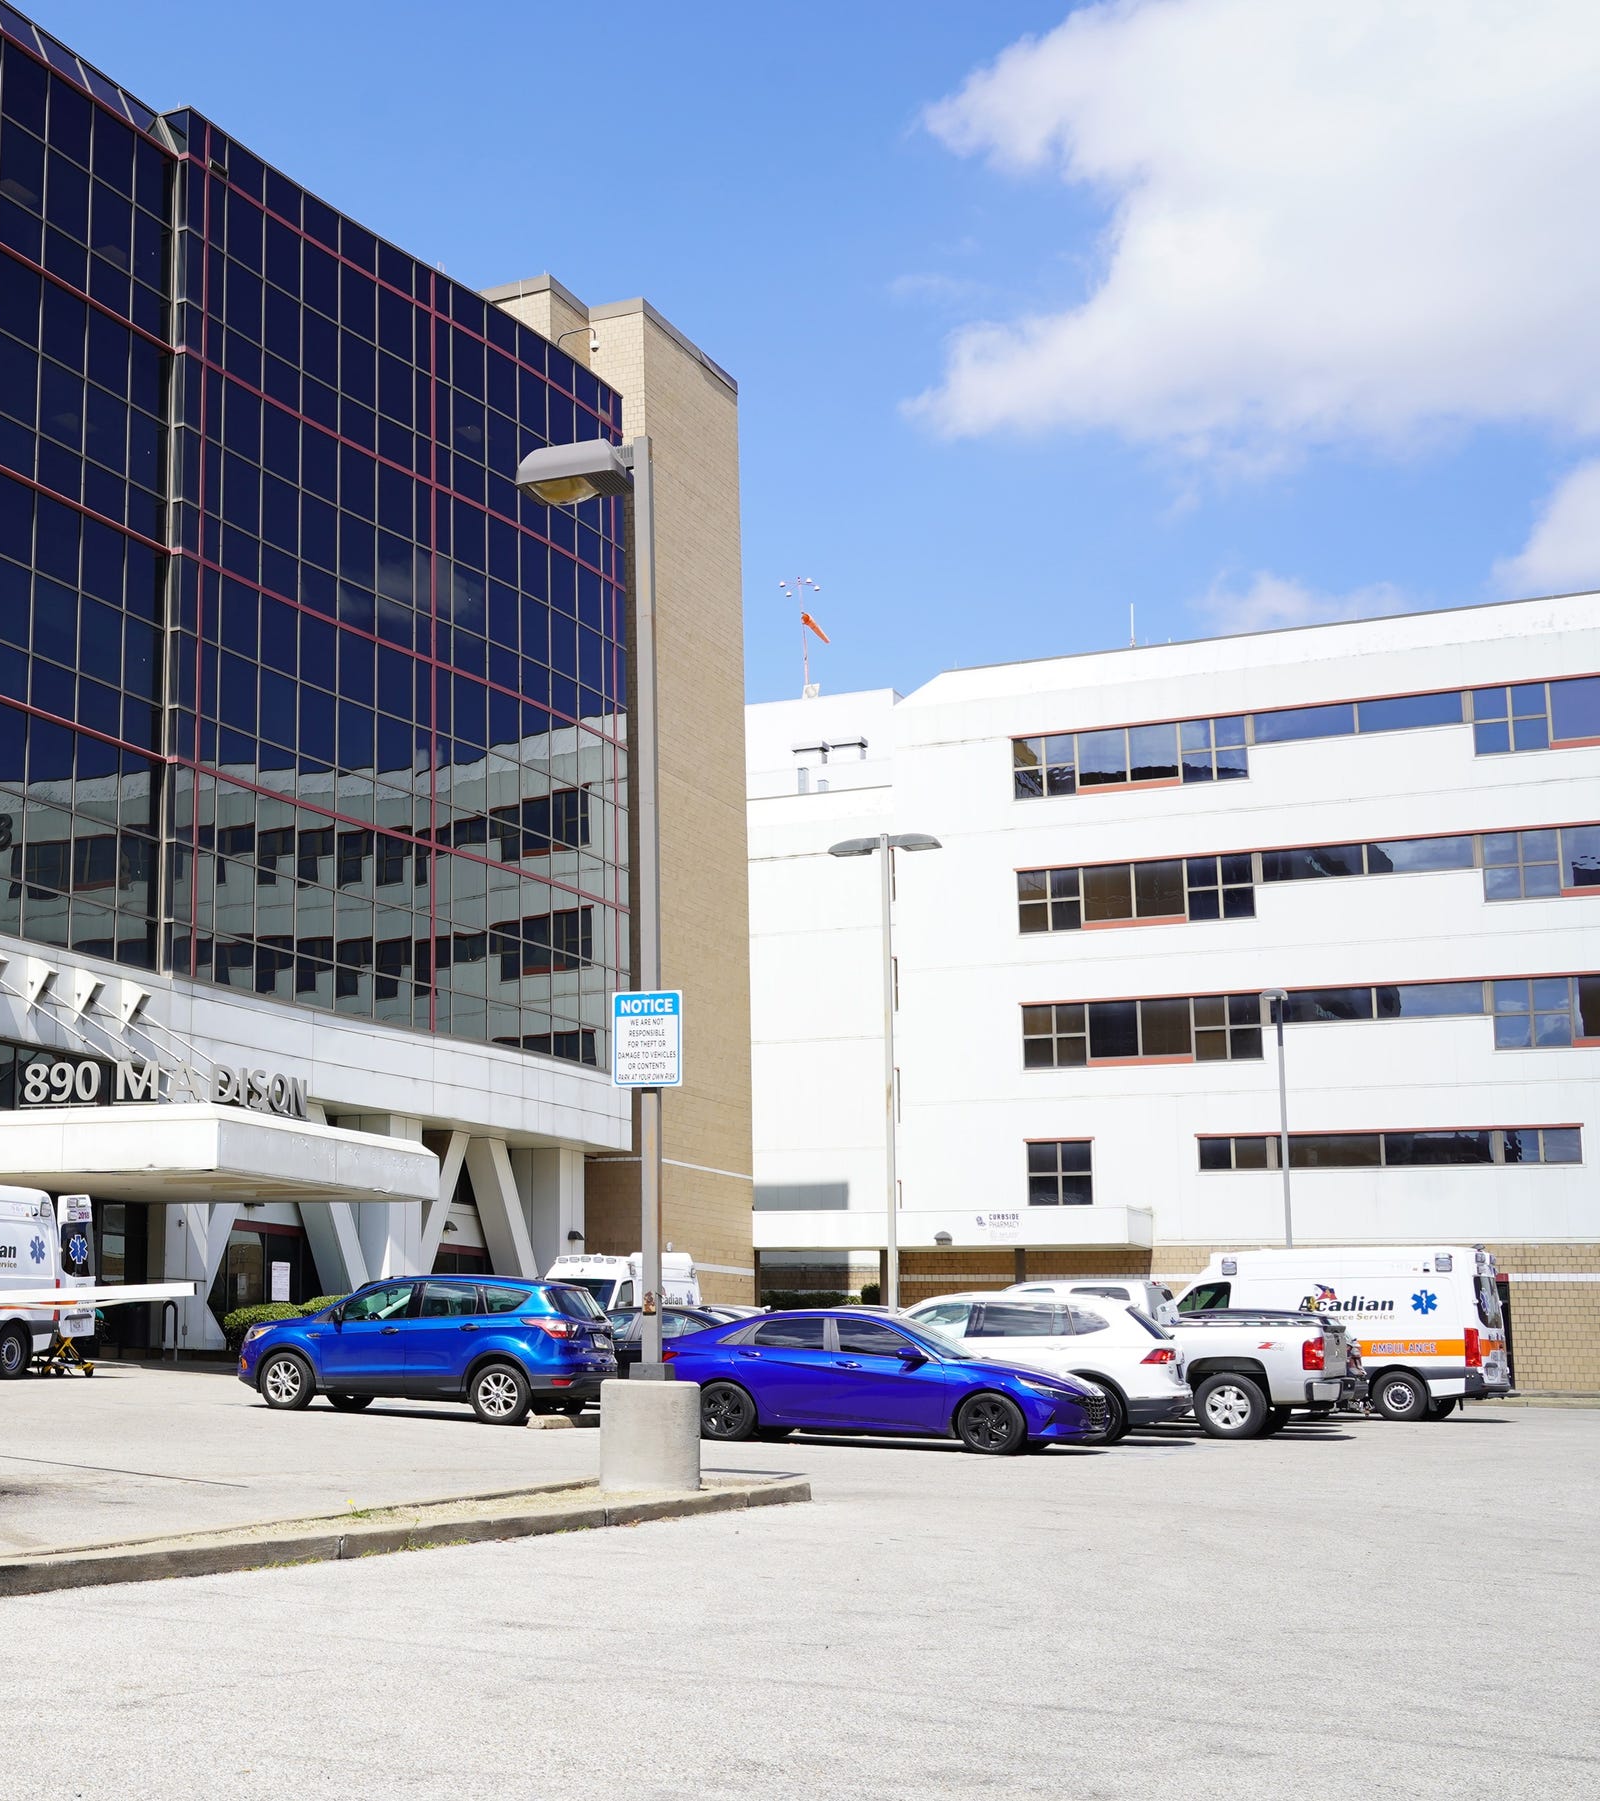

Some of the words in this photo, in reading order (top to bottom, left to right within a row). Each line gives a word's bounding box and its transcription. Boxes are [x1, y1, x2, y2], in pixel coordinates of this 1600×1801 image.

[621, 998, 674, 1014] NOTICE
[630, 1018, 639, 1026] WE
[641, 1018, 651, 1026] ARE
[652, 1018, 664, 1026] NOT
[629, 1029, 665, 1037] RESPONSIBLE
[627, 1040, 639, 1048] FOR
[640, 1040, 657, 1048] THEFT
[658, 1040, 666, 1048] OR
[617, 1051, 640, 1060] DAMAGE
[642, 1051, 649, 1059] TO
[650, 1050, 676, 1058] VEHICLES
[627, 1062, 636, 1070] OR
[637, 1062, 666, 1070] CONTENTS
[618, 1073, 630, 1081] PARK
[631, 1073, 638, 1081] AT
[639, 1073, 651, 1081] YOUR
[664, 1072, 676, 1080] RISK
[24, 1060, 100, 1103] 890
[116, 1060, 308, 1118] MADISON
[1299, 1295, 1394, 1312] Acadian
[1356, 1312, 1396, 1321] Service
[1371, 1342, 1437, 1355] AMBULANCE
